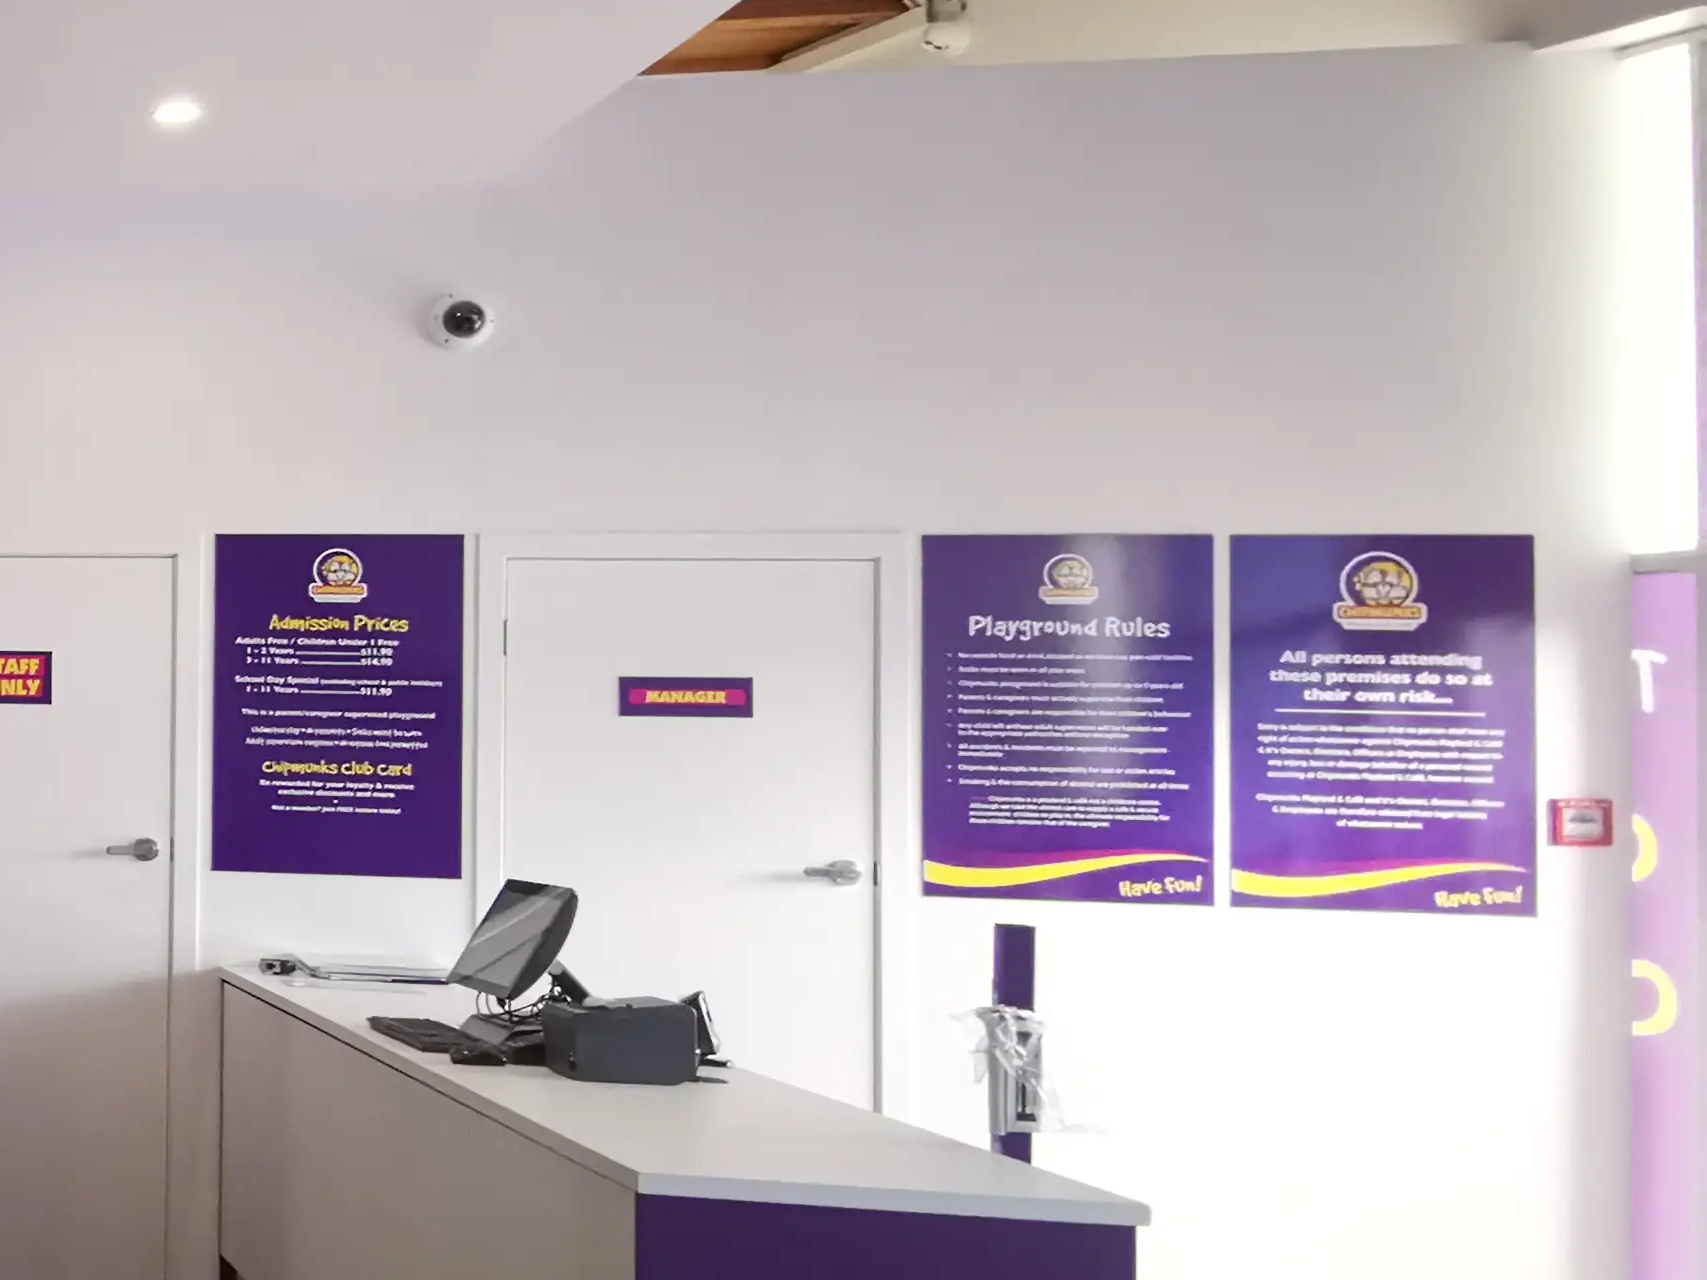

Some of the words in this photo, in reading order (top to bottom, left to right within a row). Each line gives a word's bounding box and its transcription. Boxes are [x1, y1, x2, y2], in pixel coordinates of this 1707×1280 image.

[269, 614, 350, 632] Admission
[353, 615, 410, 633] Prices
[968, 614, 1098, 642] Playground
[1104, 616, 1171, 639] Rules
[1279, 650, 1306, 665] All
[1312, 652, 1385, 668] persons
[1390, 652, 1482, 670] attending
[1269, 669, 1321, 684] these
[1326, 670, 1410, 687] premises
[1415, 671, 1440, 685] do
[1445, 673, 1467, 685] so
[1471, 672, 1493, 686] at
[645, 690, 727, 704] MANAGER
[1303, 688, 1350, 702] their
[1354, 690, 1395, 703] own
[262, 760, 338, 776] Chipmunks
[340, 760, 374, 776] Club
[376, 763, 413, 776] Card
[1119, 879, 1163, 898] Have
